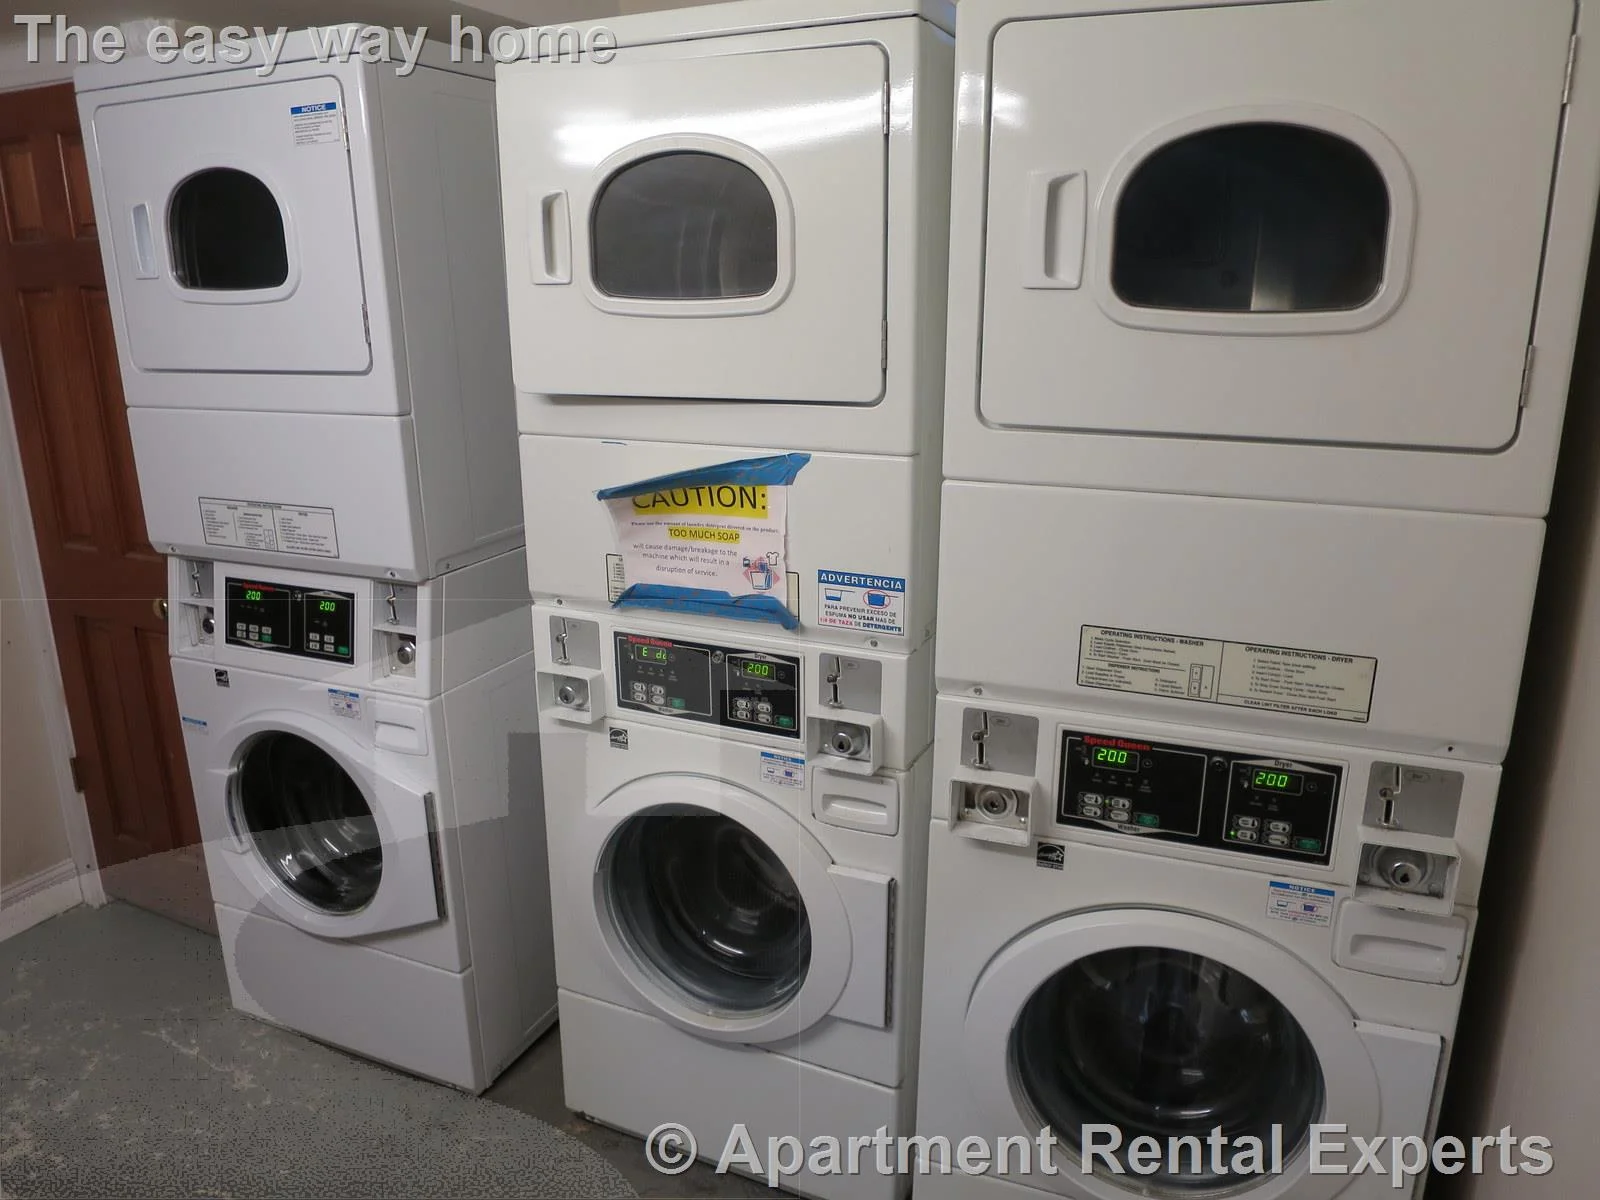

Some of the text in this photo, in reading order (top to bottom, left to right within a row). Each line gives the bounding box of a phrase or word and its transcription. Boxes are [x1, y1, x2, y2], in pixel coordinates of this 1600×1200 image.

[301, 103, 326, 113] NOTICE
[631, 485, 766, 509] CAUTION:
[669, 528, 740, 542] TOO MUCH SOAP
[663, 544, 718, 556] damage/breakage
[727, 549, 738, 557] the
[642, 551, 668, 560] machine
[669, 553, 688, 562] which
[689, 555, 700, 563] will
[700, 556, 717, 565] result
[718, 558, 724, 566] in
[655, 564, 718, 578] disruption of service.
[820, 572, 902, 589] ADVERTENCIA
[246, 590, 261, 601] 200
[319, 600, 336, 612] 200
[839, 605, 866, 614] PREVENIR
[866, 609, 889, 617] EXCESO
[825, 610, 847, 618] ESPUMA
[862, 622, 902, 633] DETERGENTE
[1100, 629, 1133, 639] OPERATING
[1133, 633, 1176, 644] INSTRUCTIONS
[1179, 639, 1204, 647] WASHER
[642, 646, 648, 657] E
[1244, 646, 1280, 656] OPERATING
[1281, 650, 1327, 661] INSTRUCTIONS
[1331, 655, 1354, 664] DRYER
[747, 662, 769, 676] 200
[1082, 734, 1153, 751] Speed Queen
[1097, 748, 1128, 764] 200
[1274, 759, 1294, 769] Dryer
[1255, 771, 1288, 788] 200
[1117, 823, 1141, 833] Washer
[1288, 883, 1315, 894] NOTICE
